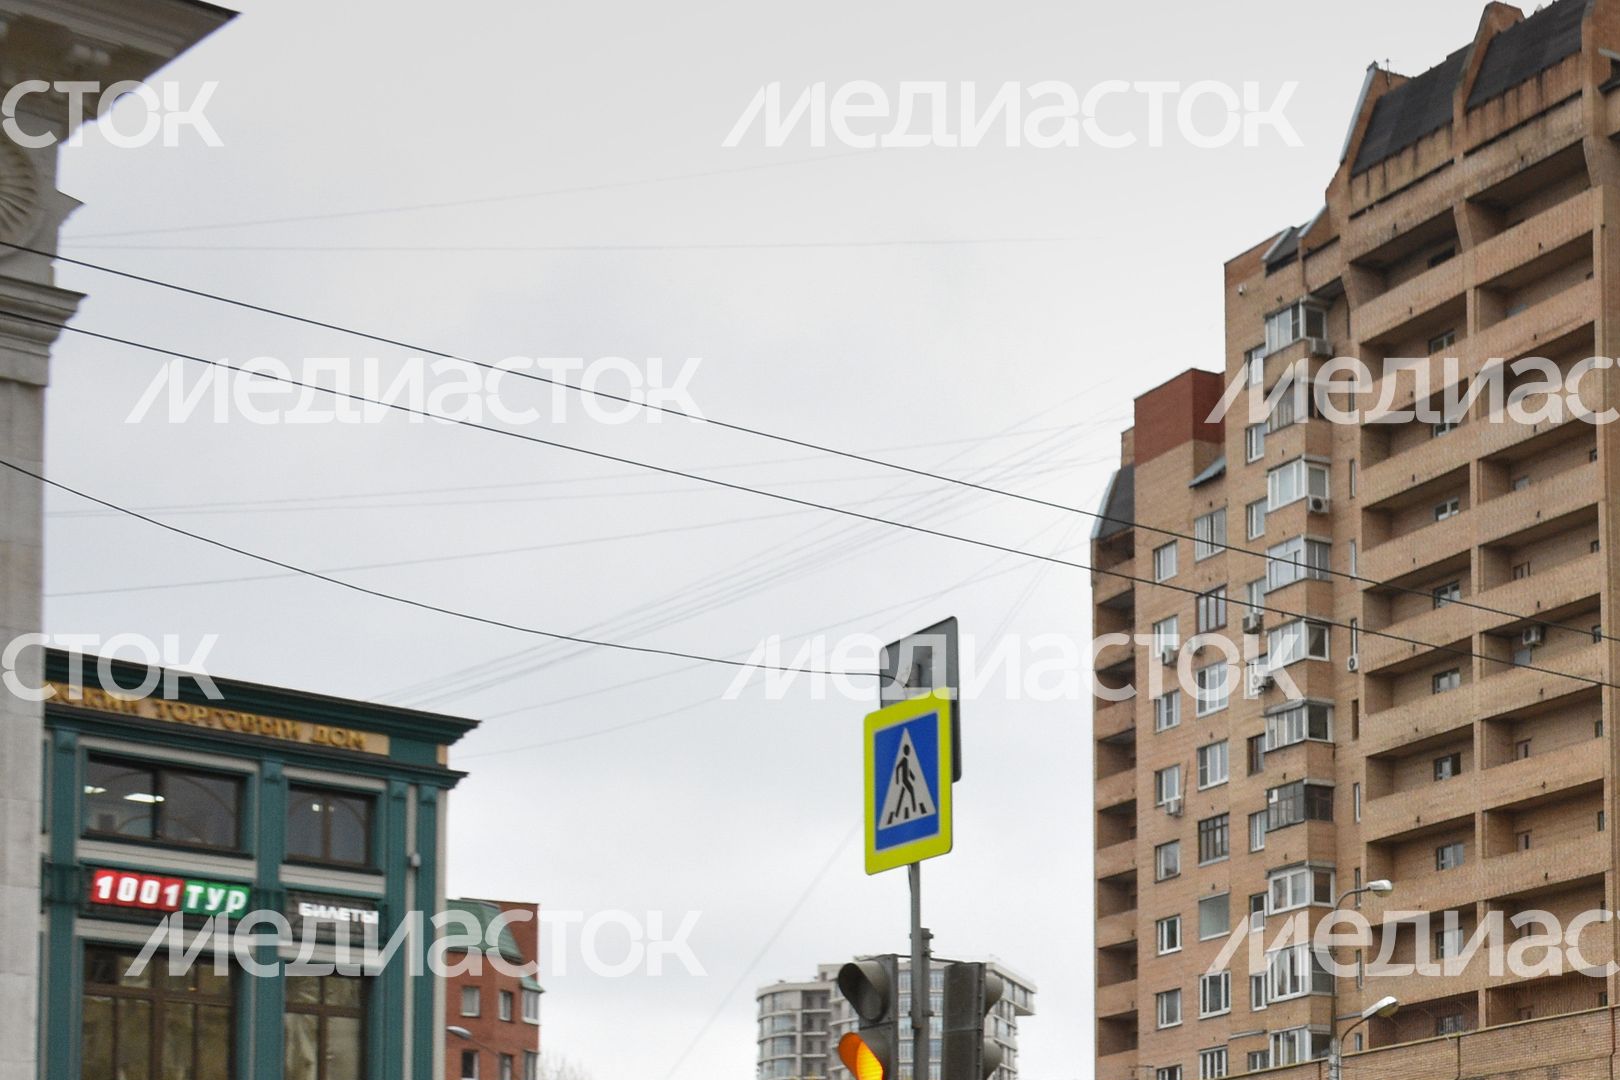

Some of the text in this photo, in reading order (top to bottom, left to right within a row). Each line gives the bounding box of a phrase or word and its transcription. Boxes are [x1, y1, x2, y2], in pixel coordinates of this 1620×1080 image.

[154, 700, 300, 739] ТОРГОВЫЙ
[310, 722, 367, 750] ДОМ
[298, 901, 379, 924] БИЛЕТЫ
